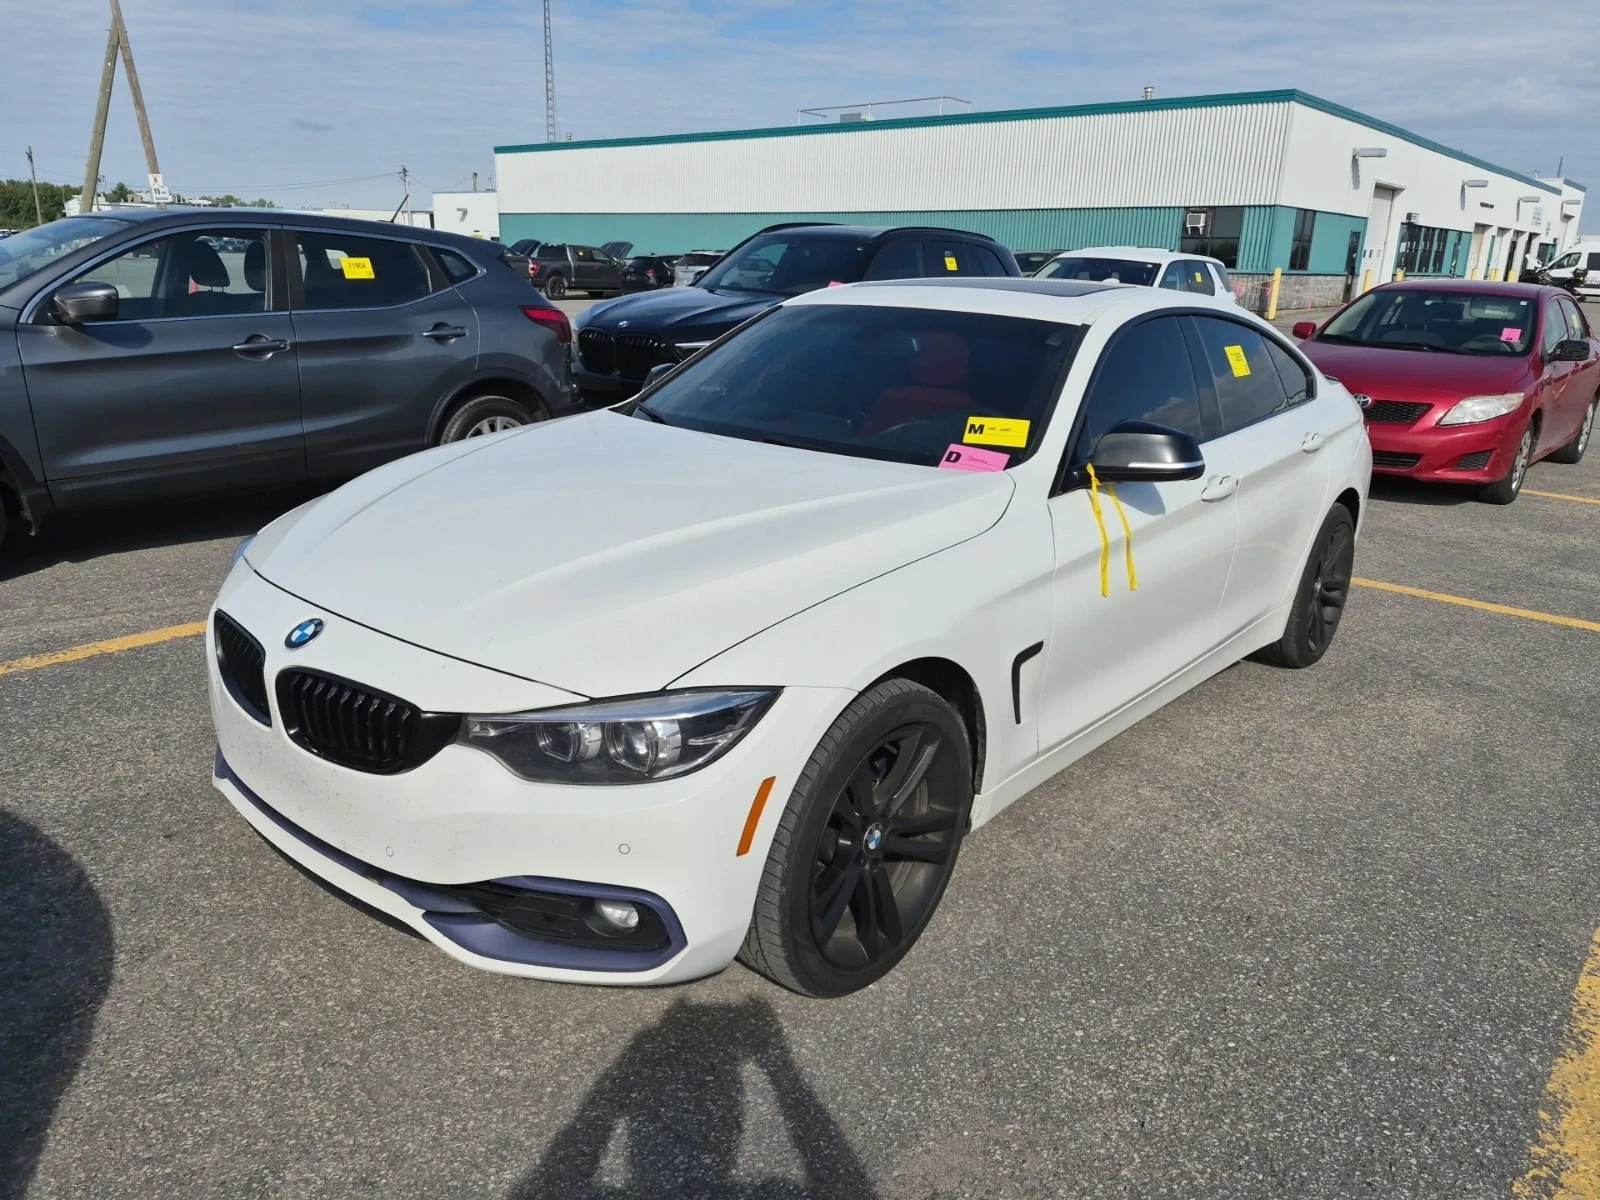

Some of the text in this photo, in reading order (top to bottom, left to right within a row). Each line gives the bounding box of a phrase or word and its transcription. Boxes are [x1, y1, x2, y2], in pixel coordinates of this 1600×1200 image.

[153, 187, 161, 195] 15
[456, 207, 468, 222] 7
[967, 423, 985, 435] M
[944, 450, 962, 463] D
